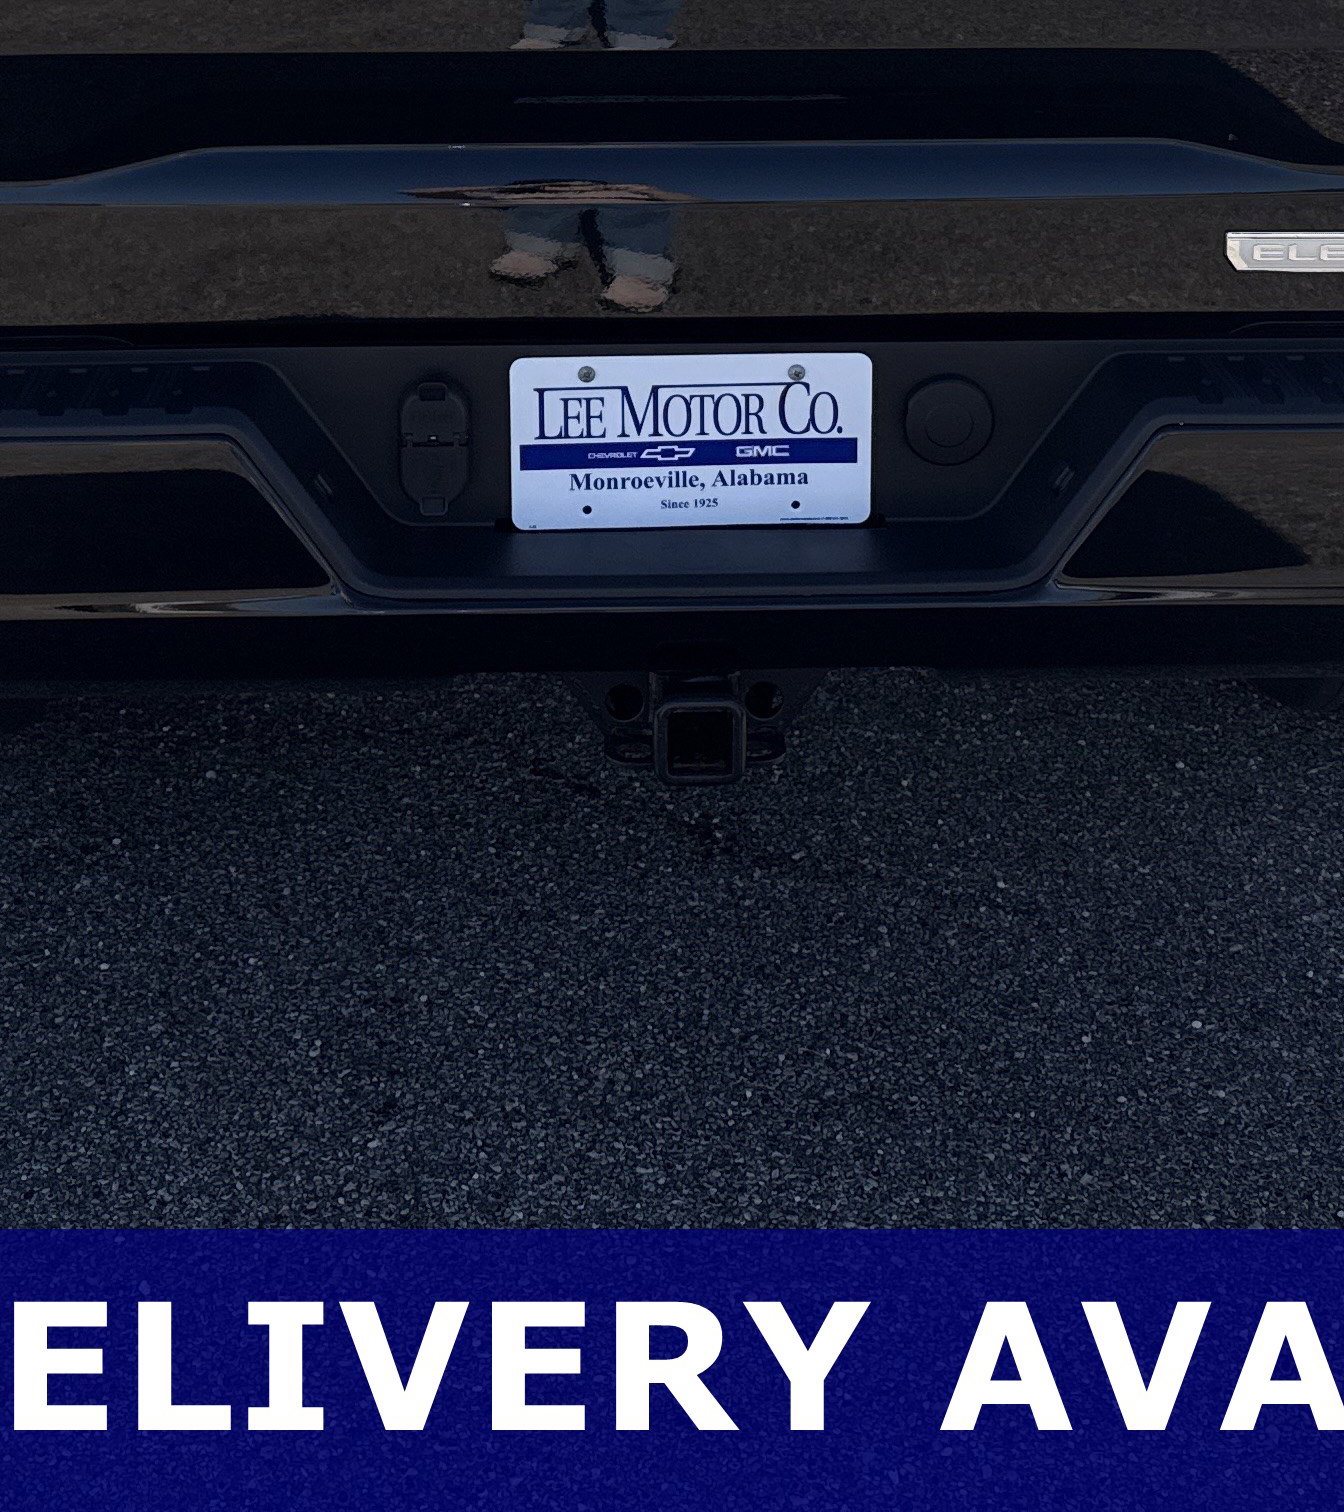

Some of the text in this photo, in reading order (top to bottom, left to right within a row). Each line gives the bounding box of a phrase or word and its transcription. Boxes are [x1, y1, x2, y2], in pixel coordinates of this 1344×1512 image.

[533, 387, 607, 441] LEE
[616, 383, 768, 439] MOTOR
[587, 451, 639, 460] CHEVROLET
[735, 444, 790, 458] GMC
[568, 468, 809, 492] Monroeville, Alabama
[660, 497, 719, 510] Since 1925
